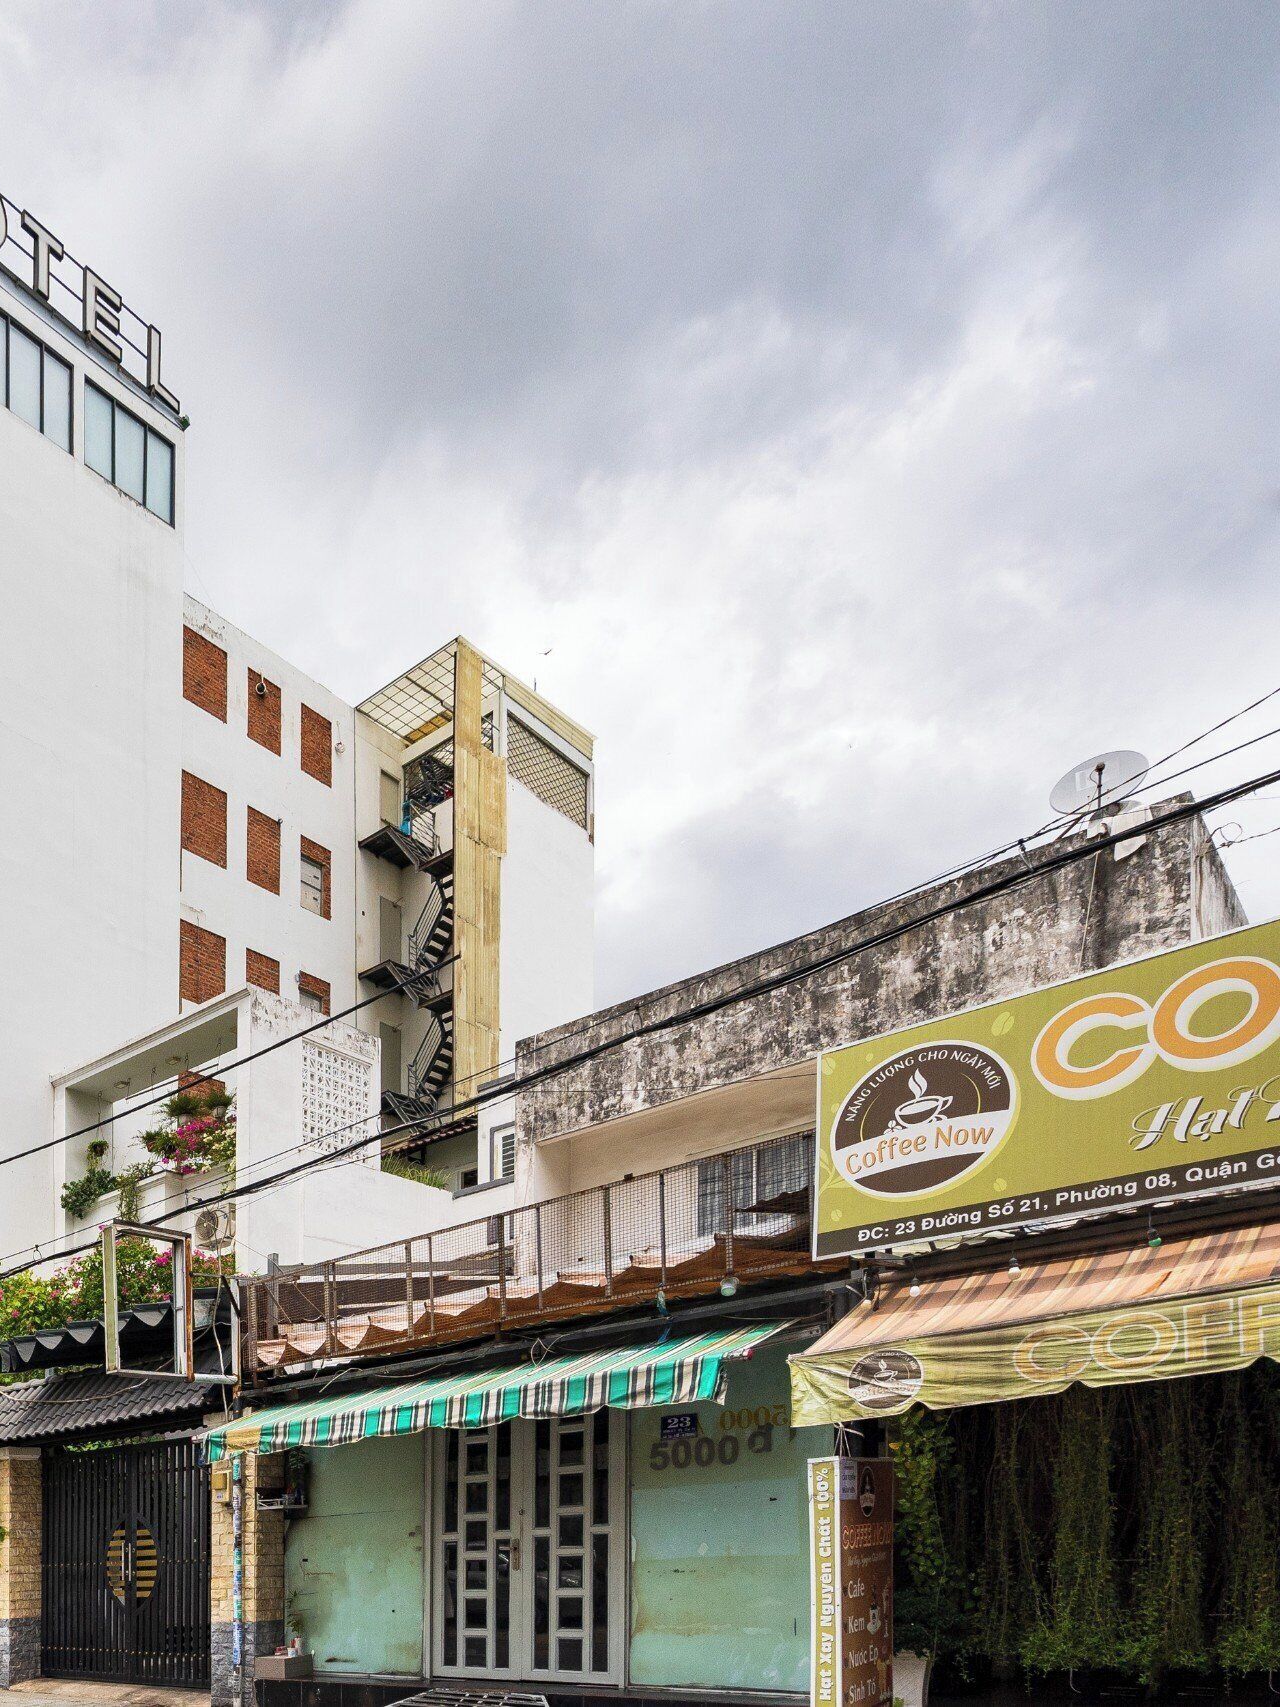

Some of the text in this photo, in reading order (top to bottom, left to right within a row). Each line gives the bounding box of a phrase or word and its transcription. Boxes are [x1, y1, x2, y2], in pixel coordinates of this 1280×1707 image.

[845, 1050, 1002, 1122] NĂNG LƯỢNG CHO NGÀY MỚI
[845, 1125, 995, 1175] Coffee Now
[858, 1228, 889, 1242] ĐC:
[895, 1221, 916, 1235] 23
[921, 1210, 982, 1231] Đường
[988, 1200, 1014, 1218] Số
[1019, 1197, 1049, 1212] 21,
[1055, 1180, 1138, 1206] Phường
[1145, 1173, 1177, 1188] 08,
[1185, 1160, 1247, 1182] Quận
[667, 1416, 691, 1429] 23
[649, 1435, 740, 1471] 5000
[816, 1467, 831, 1511] 100%
[841, 1523, 872, 1551] COFFEE
[847, 1578, 866, 1599] Cafe
[848, 1616, 866, 1634] Kem
[820, 1632, 834, 1665] Xay
